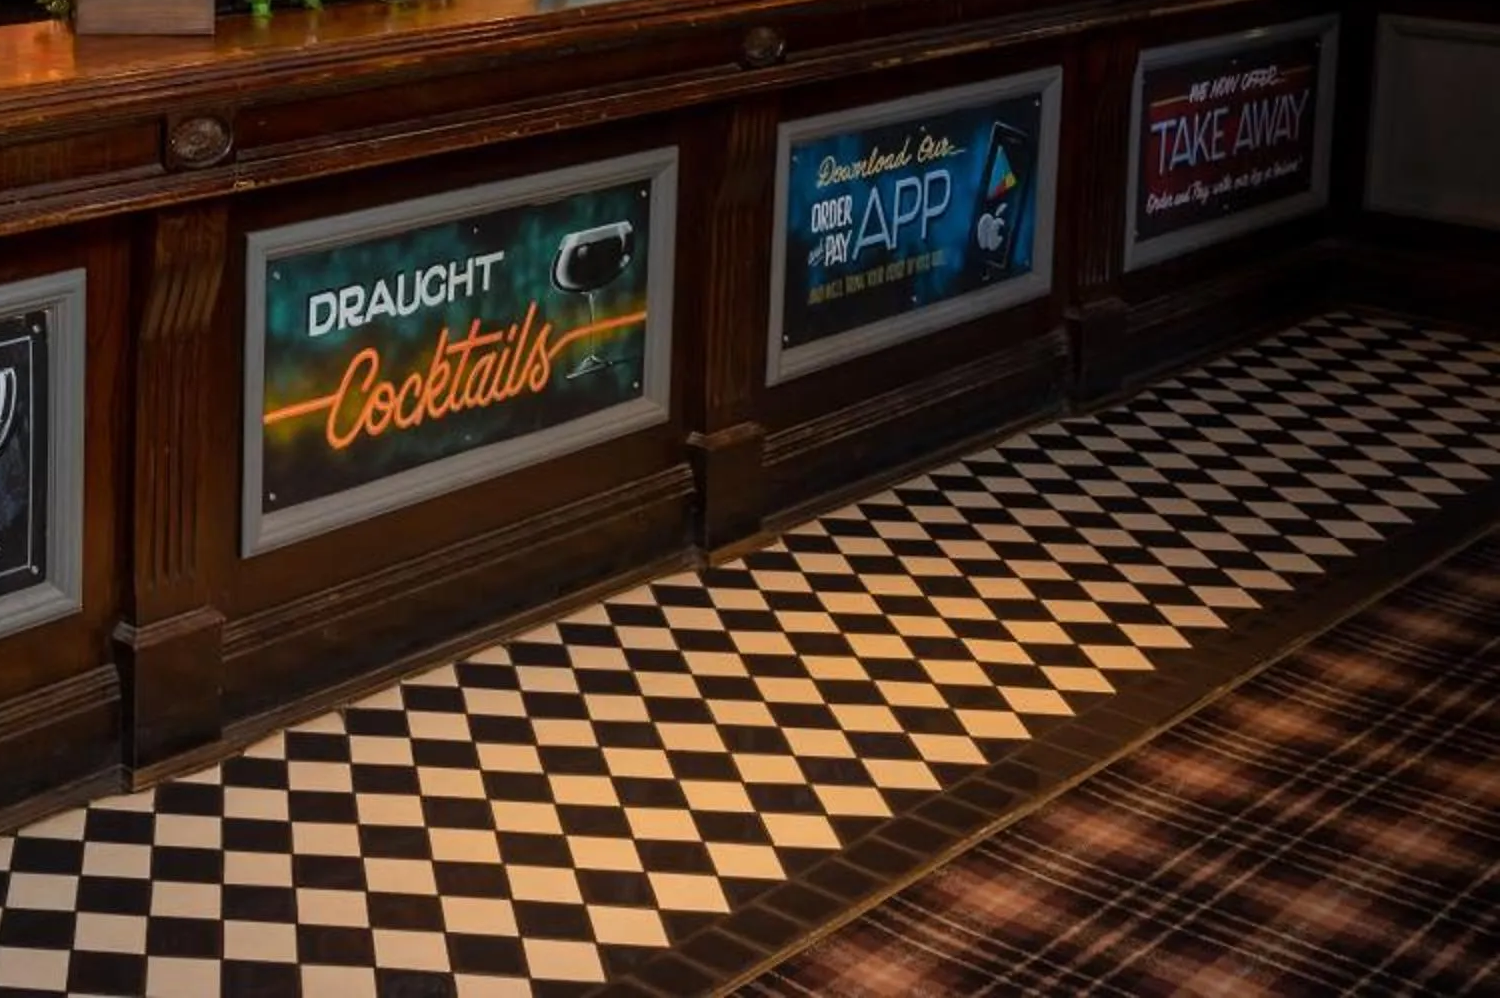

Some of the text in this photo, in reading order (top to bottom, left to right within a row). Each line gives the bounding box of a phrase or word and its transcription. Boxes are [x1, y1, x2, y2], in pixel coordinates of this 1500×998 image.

[816, 134, 913, 190] Download
[1151, 89, 1310, 176] TAKE AWAY
[811, 194, 853, 234] ORDER
[824, 230, 853, 267] PAY
[852, 169, 951, 262] APP
[307, 250, 505, 338] DRAUGHT
[325, 299, 553, 451] Cocktails
